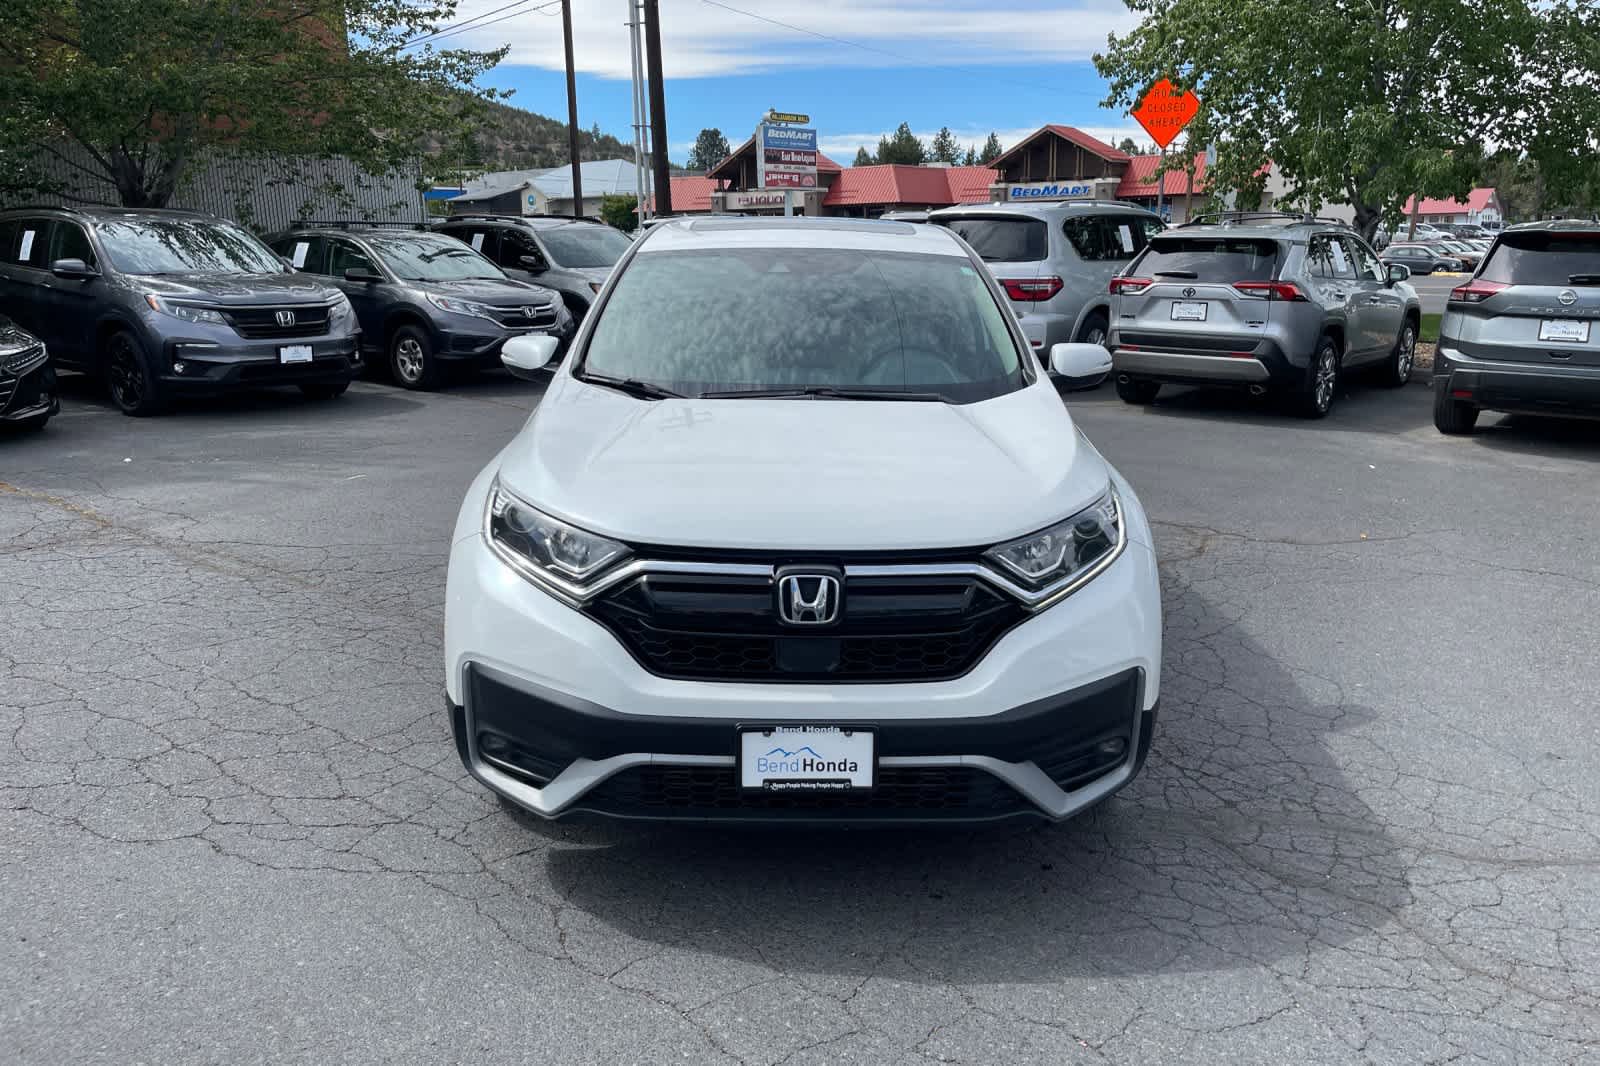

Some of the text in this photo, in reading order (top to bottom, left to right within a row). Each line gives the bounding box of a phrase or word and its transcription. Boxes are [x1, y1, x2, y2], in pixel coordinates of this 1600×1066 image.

[1147, 103, 1186, 112] CLOSED
[1149, 117, 1181, 127] AHEAD
[776, 726, 841, 734] Bend Honda
[757, 757, 858, 773] Bend Honda
